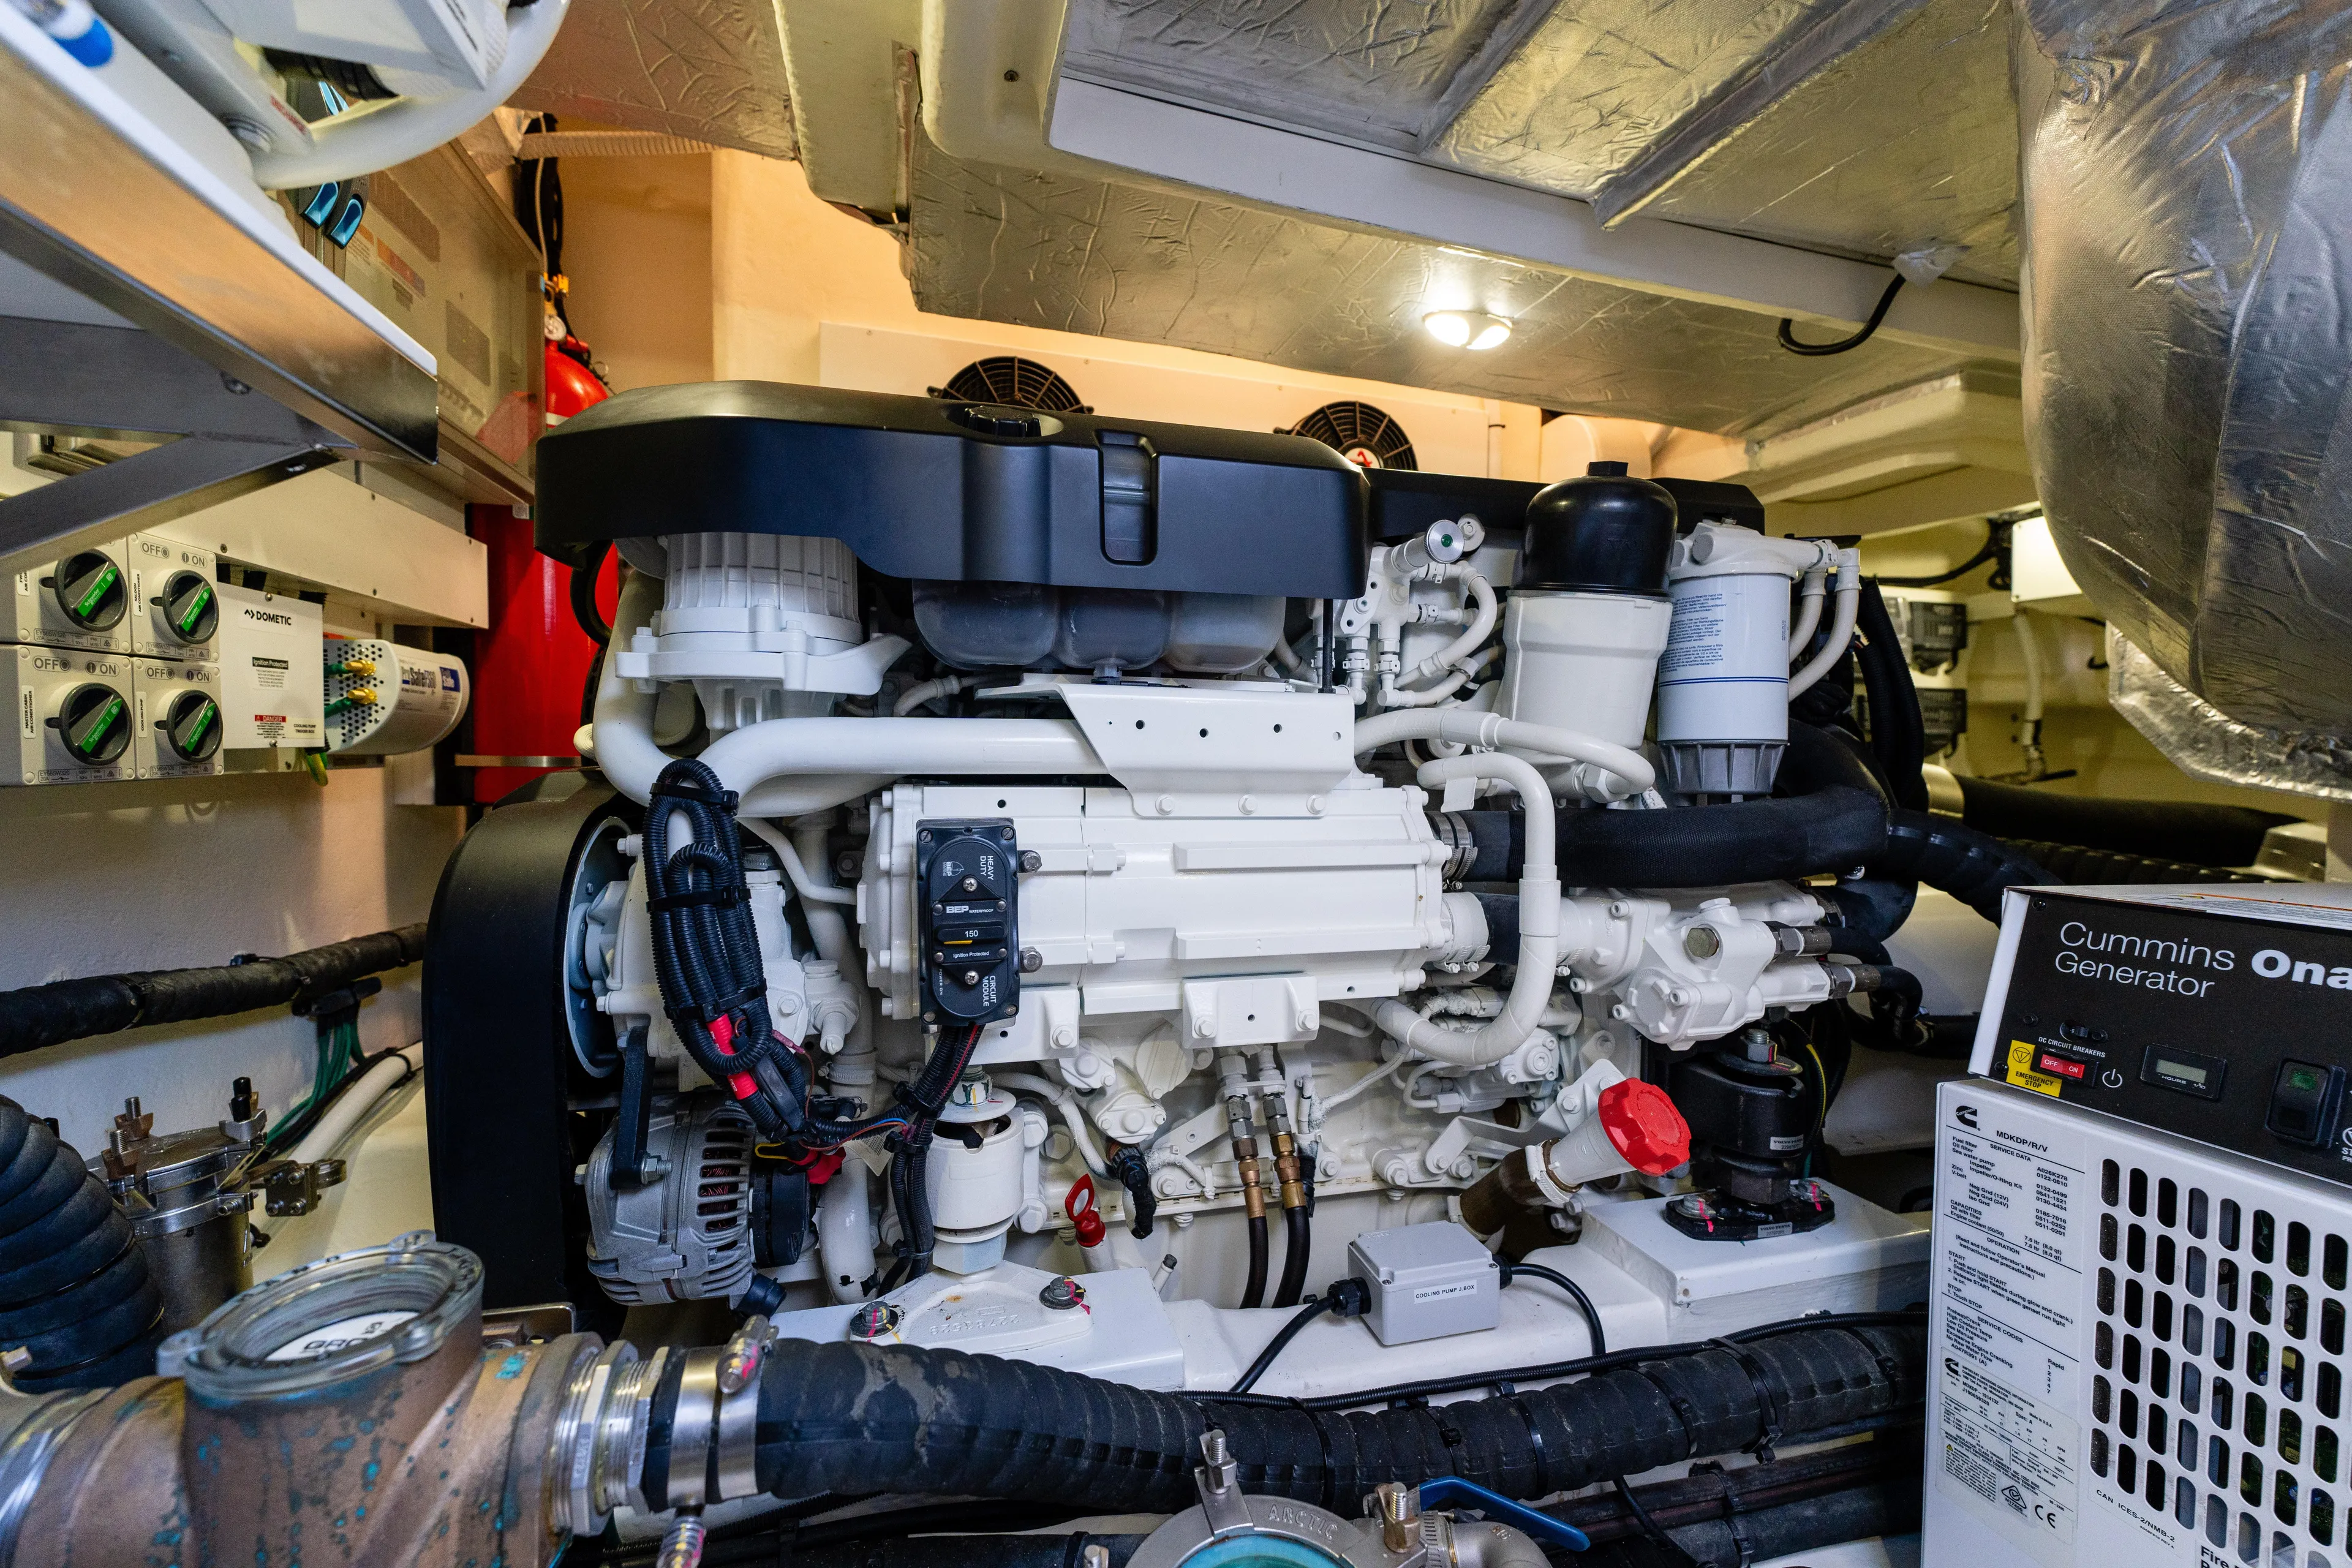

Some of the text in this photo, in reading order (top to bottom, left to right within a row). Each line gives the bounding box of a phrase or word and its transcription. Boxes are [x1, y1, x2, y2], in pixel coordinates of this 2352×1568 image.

[141, 543, 161, 556] OFF
[192, 556, 205, 567] ON
[85, 589, 99, 607] Schneider
[256, 611, 292, 625] DOMETIC
[34, 658, 60, 670] OFF
[100, 664, 116, 674] ON
[147, 668, 166, 678] OFF
[197, 672, 209, 682] ON
[946, 905, 969, 914] BEP
[2060, 921, 2235, 971] Cummins
[2055, 951, 2215, 998] Generator
[2048, 1039, 2073, 1050] CIRCUIT
[2073, 1045, 2106, 1058] BREAKERS
[2016, 1071, 2054, 1087] EMERGENCY
[2025, 1080, 2041, 1089] STOP
[2162, 1075, 2187, 1085] HOURS
[1956, 1107, 1977, 1117] Cummins
[1961, 1145, 1973, 1153] filter
[1996, 1130, 2048, 1153] MDKDP/R/V
[1963, 1152, 1978, 1161] water
[1980, 1158, 1996, 1168] pump
[1990, 1144, 2032, 1163] SERVICE DATA
[1952, 1164, 1964, 1172] Zinc
[1970, 1160, 1992, 1172] Impeller
[1951, 1170, 1967, 1180] V-belt
[1970, 1166, 2013, 1187] Impeller/O-Ring
[2037, 1167, 2068, 1182] A026K278
[2037, 1173, 2068, 1188] 0122-0810
[1969, 1183, 2009, 1202] Neg Gnd (12V)
[2036, 1184, 2068, 1199] 0132-0499
[2036, 1190, 2067, 1205] 0541-1521
[1951, 1199, 1982, 1216] CAPACITIES
[2036, 1196, 2067, 1212] 0130-4434
[2035, 1208, 2067, 1224] 0185-7016
[2035, 1215, 2067, 1231] 0511-0252
[1951, 1211, 2005, 1238] Engine coolant (50/50)
[2035, 1221, 2065, 1237] 0511-0201
[1987, 1237, 2020, 1256] OPERATION
[2042, 1243, 2053, 1251] (8.0
[1948, 1250, 1966, 1262] START
[1956, 1234, 1970, 1245] (Read
[1981, 1245, 1997, 1255] follow
[1997, 1253, 2025, 1269] Operator's
[2026, 1265, 2046, 1278] Manual
[2000, 1261, 2035, 1280] precautions.)
[1947, 1283, 1962, 1294] STOP
[1953, 1270, 1973, 1283] Release
[1973, 1279, 1991, 1291] START
[1991, 1288, 2005, 1299] when
[2006, 1295, 2022, 1306] green
[2022, 1303, 2041, 1316] genset
[2052, 1317, 2066, 1328] light
[1947, 1306, 1981, 1327] Preheat/Crank
[1947, 1312, 1993, 1340] High Coolant Temp
[1977, 1316, 2024, 1343] SERVICE CODES
[1966, 1327, 1988, 1343] Pressure
[1947, 1329, 2013, 1369] Excessive Engine Cranking
[1951, 1343, 1988, 1366] A047R391 (A)
[2048, 1358, 2065, 1371] Rapid
[2015, 1412, 2028, 1422] Spec:
[1268, 1504, 1338, 1540] ARCTIC
[2035, 1504, 2056, 1529] CE
[2097, 1490, 2175, 1543] CAN ICES-2/NMB-2
[2201, 1545, 2230, 1568] Fire
